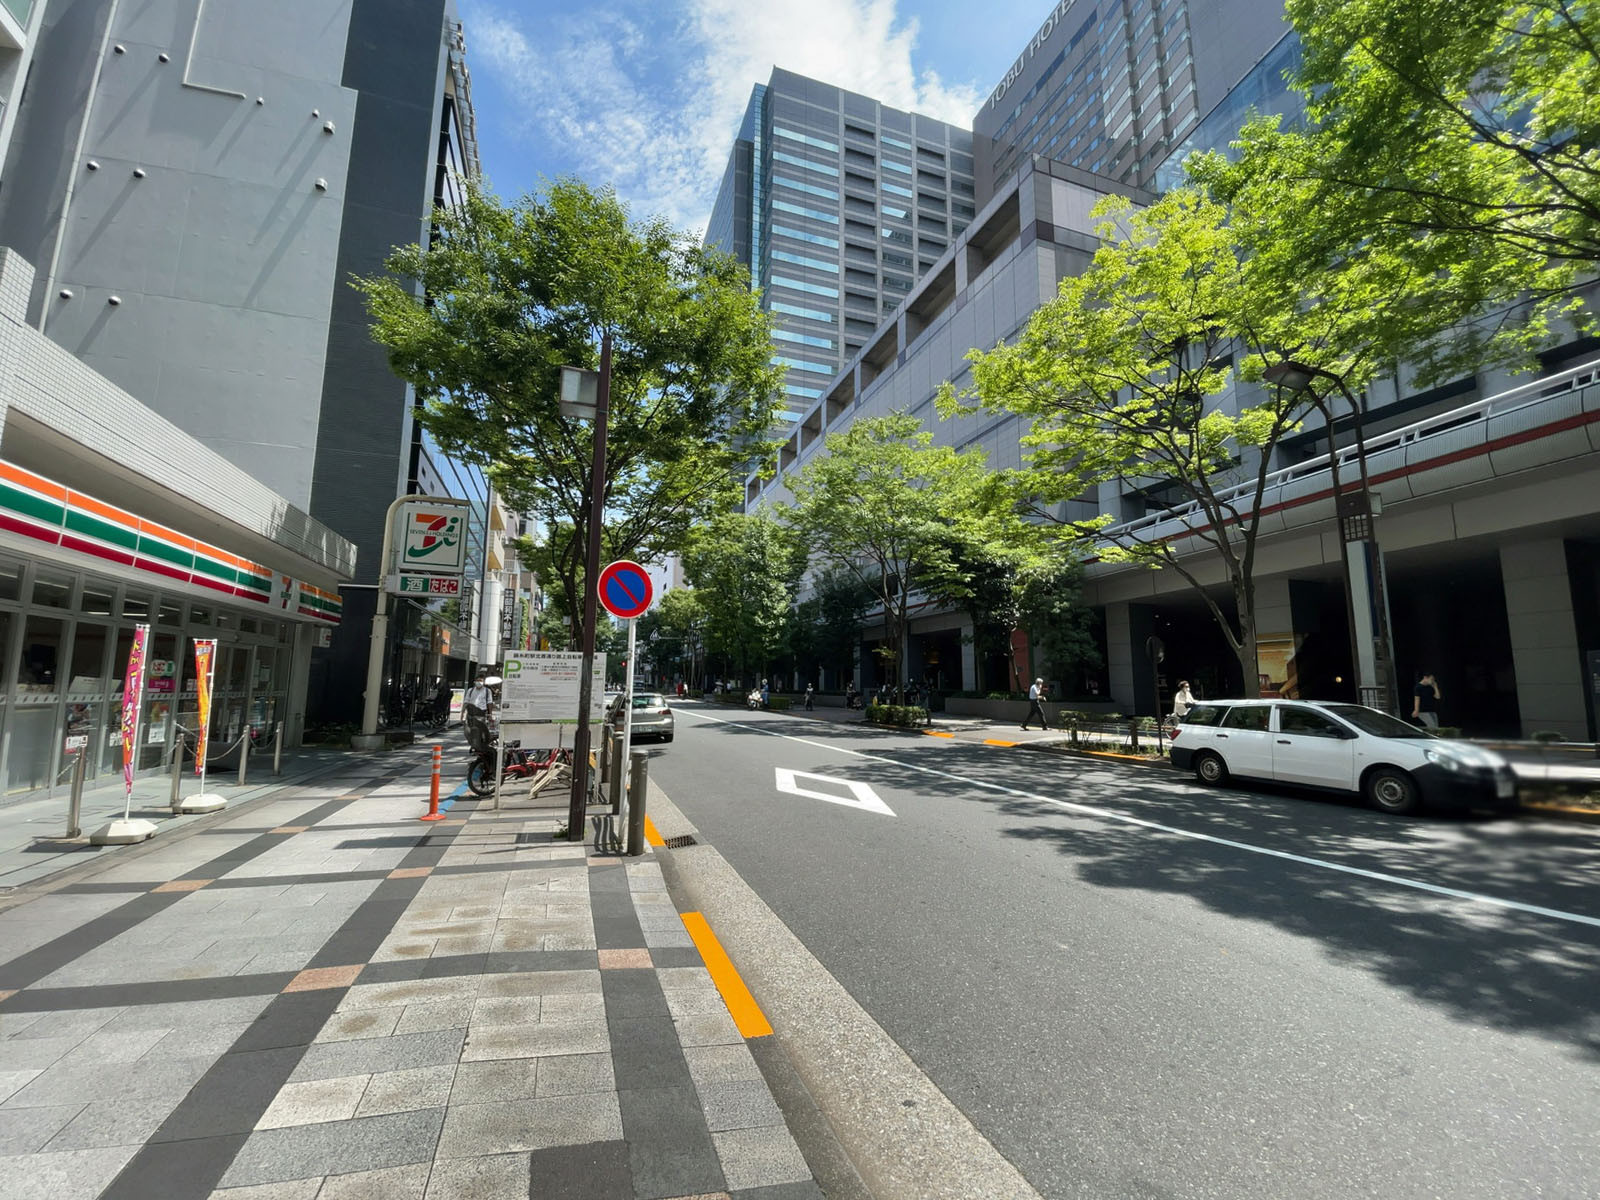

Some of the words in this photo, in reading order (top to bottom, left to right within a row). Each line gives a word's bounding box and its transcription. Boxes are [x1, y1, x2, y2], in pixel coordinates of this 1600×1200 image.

[989, 56, 1024, 109] TOBU
[407, 577, 424, 591] 酒
[431, 578, 458, 594] たばこ
[504, 660, 522, 679] P
